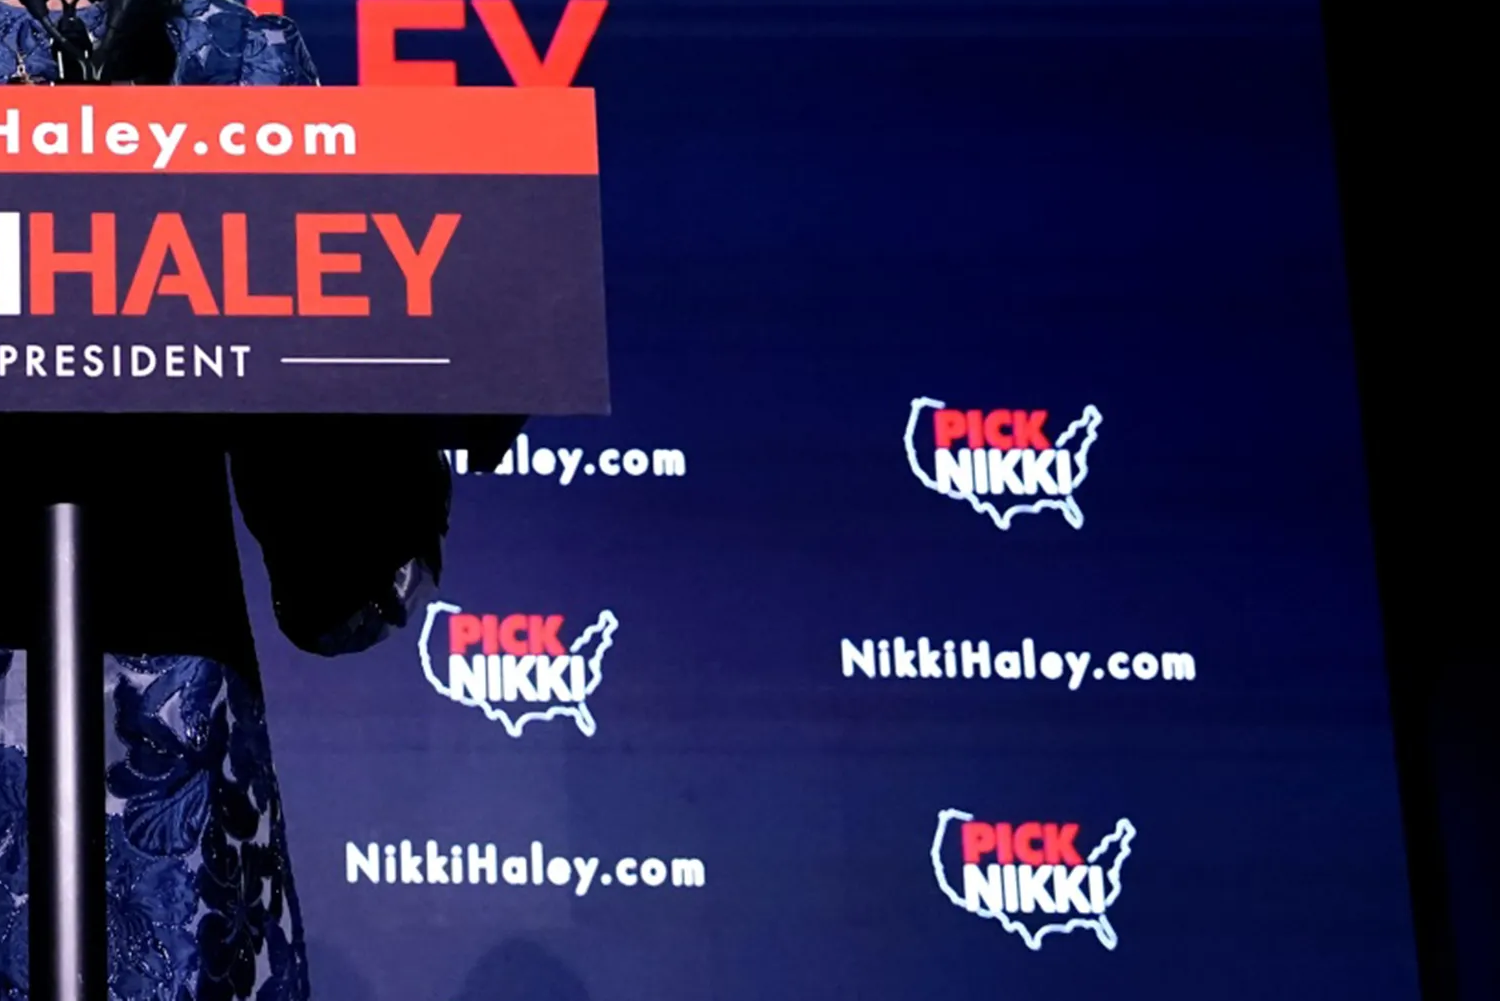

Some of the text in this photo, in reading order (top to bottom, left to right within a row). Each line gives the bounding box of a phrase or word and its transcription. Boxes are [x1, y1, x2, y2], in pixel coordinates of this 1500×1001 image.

[933, 409, 1050, 449] PICK
[934, 447, 1072, 496] NIKKI
[448, 614, 566, 655] PICK
[448, 654, 586, 702] NIKKI
[841, 636, 1197, 690] NikkiHaley.com
[961, 822, 1083, 865] PICK
[345, 839, 705, 897] NikkiHaley.com
[963, 863, 1103, 914] NIKKI
